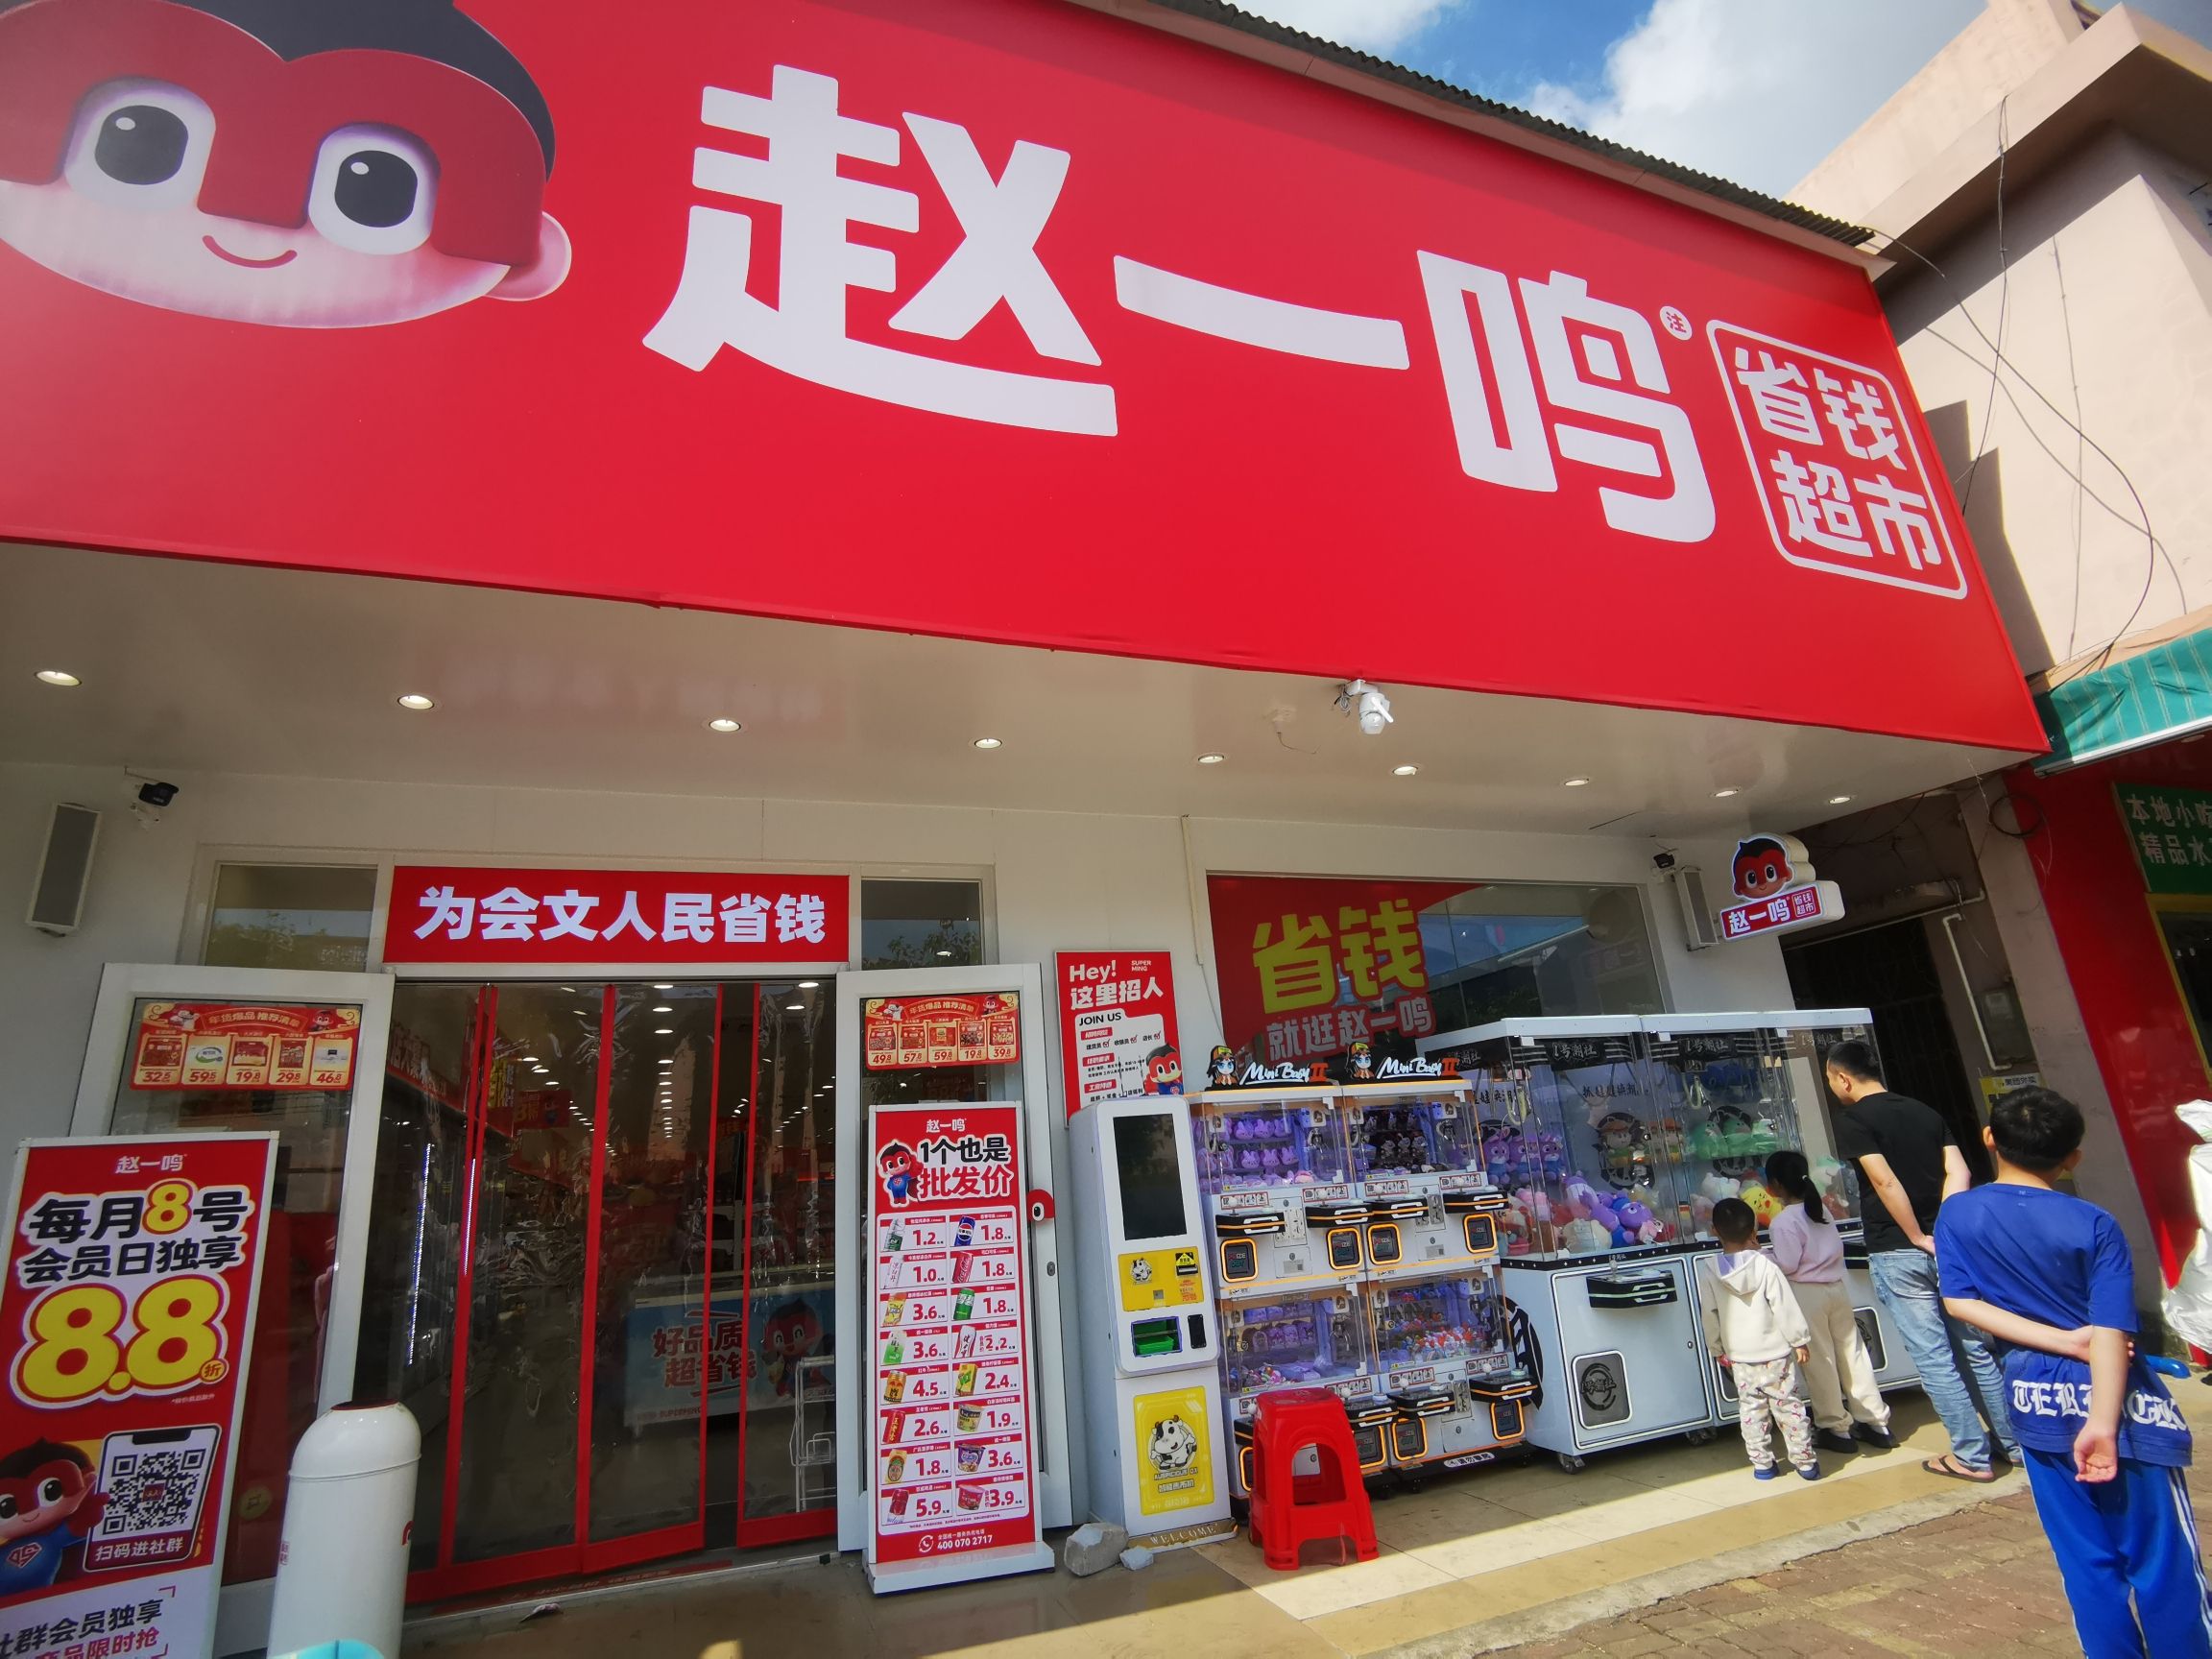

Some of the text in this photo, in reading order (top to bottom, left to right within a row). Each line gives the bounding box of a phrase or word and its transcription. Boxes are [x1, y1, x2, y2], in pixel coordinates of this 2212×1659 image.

[642, 64, 1716, 543] 赵一鸣
[1735, 347, 1907, 470] 省钱
[1770, 449, 1941, 570] 超市
[2137, 831, 2212, 866] 精品水
[413, 885, 826, 944] 为会文人民省钱
[1729, 899, 1791, 934] 赵一鸣
[1253, 899, 1426, 1014] 省钱
[1070, 960, 1117, 982] Hey!
[1070, 976, 1164, 1010] 这里招人
[1079, 1013, 1121, 1026] JOIN US
[1266, 998, 1433, 1060] 就逛赵一鸣
[926, 1118, 966, 1133] 赵一鸣
[920, 1136, 1009, 1165] 1个也是
[115, 1154, 184, 1174] 赵一鸣
[920, 1164, 1011, 1197] 批发价
[29, 1183, 248, 1244] 每月8号
[912, 1229, 937, 1246] 1.2
[981, 1225, 1004, 1241] 1.8
[23, 1236, 242, 1284] 会员日独享
[982, 1261, 1005, 1277] 1.8
[913, 1266, 937, 1284] 1.0
[913, 1303, 938, 1321] 3.6
[983, 1297, 1007, 1314] 1.8
[17, 1275, 225, 1402] 8.8
[913, 1341, 938, 1359] 3.6
[203, 1361, 222, 1378] 折
[913, 1379, 939, 1397] 4.5
[985, 1372, 1010, 1390] 2.4
[914, 1418, 940, 1437] 2.6
[987, 1410, 1011, 1429] 1.9
[916, 1457, 941, 1477] 1.8
[988, 1449, 1013, 1468] 3.6
[916, 1498, 942, 1518] 5.9
[990, 1489, 1015, 1508] 3.9
[95, 1537, 184, 1562] 扫码进社群
[937, 1534, 993, 1550] 400 070 2717
